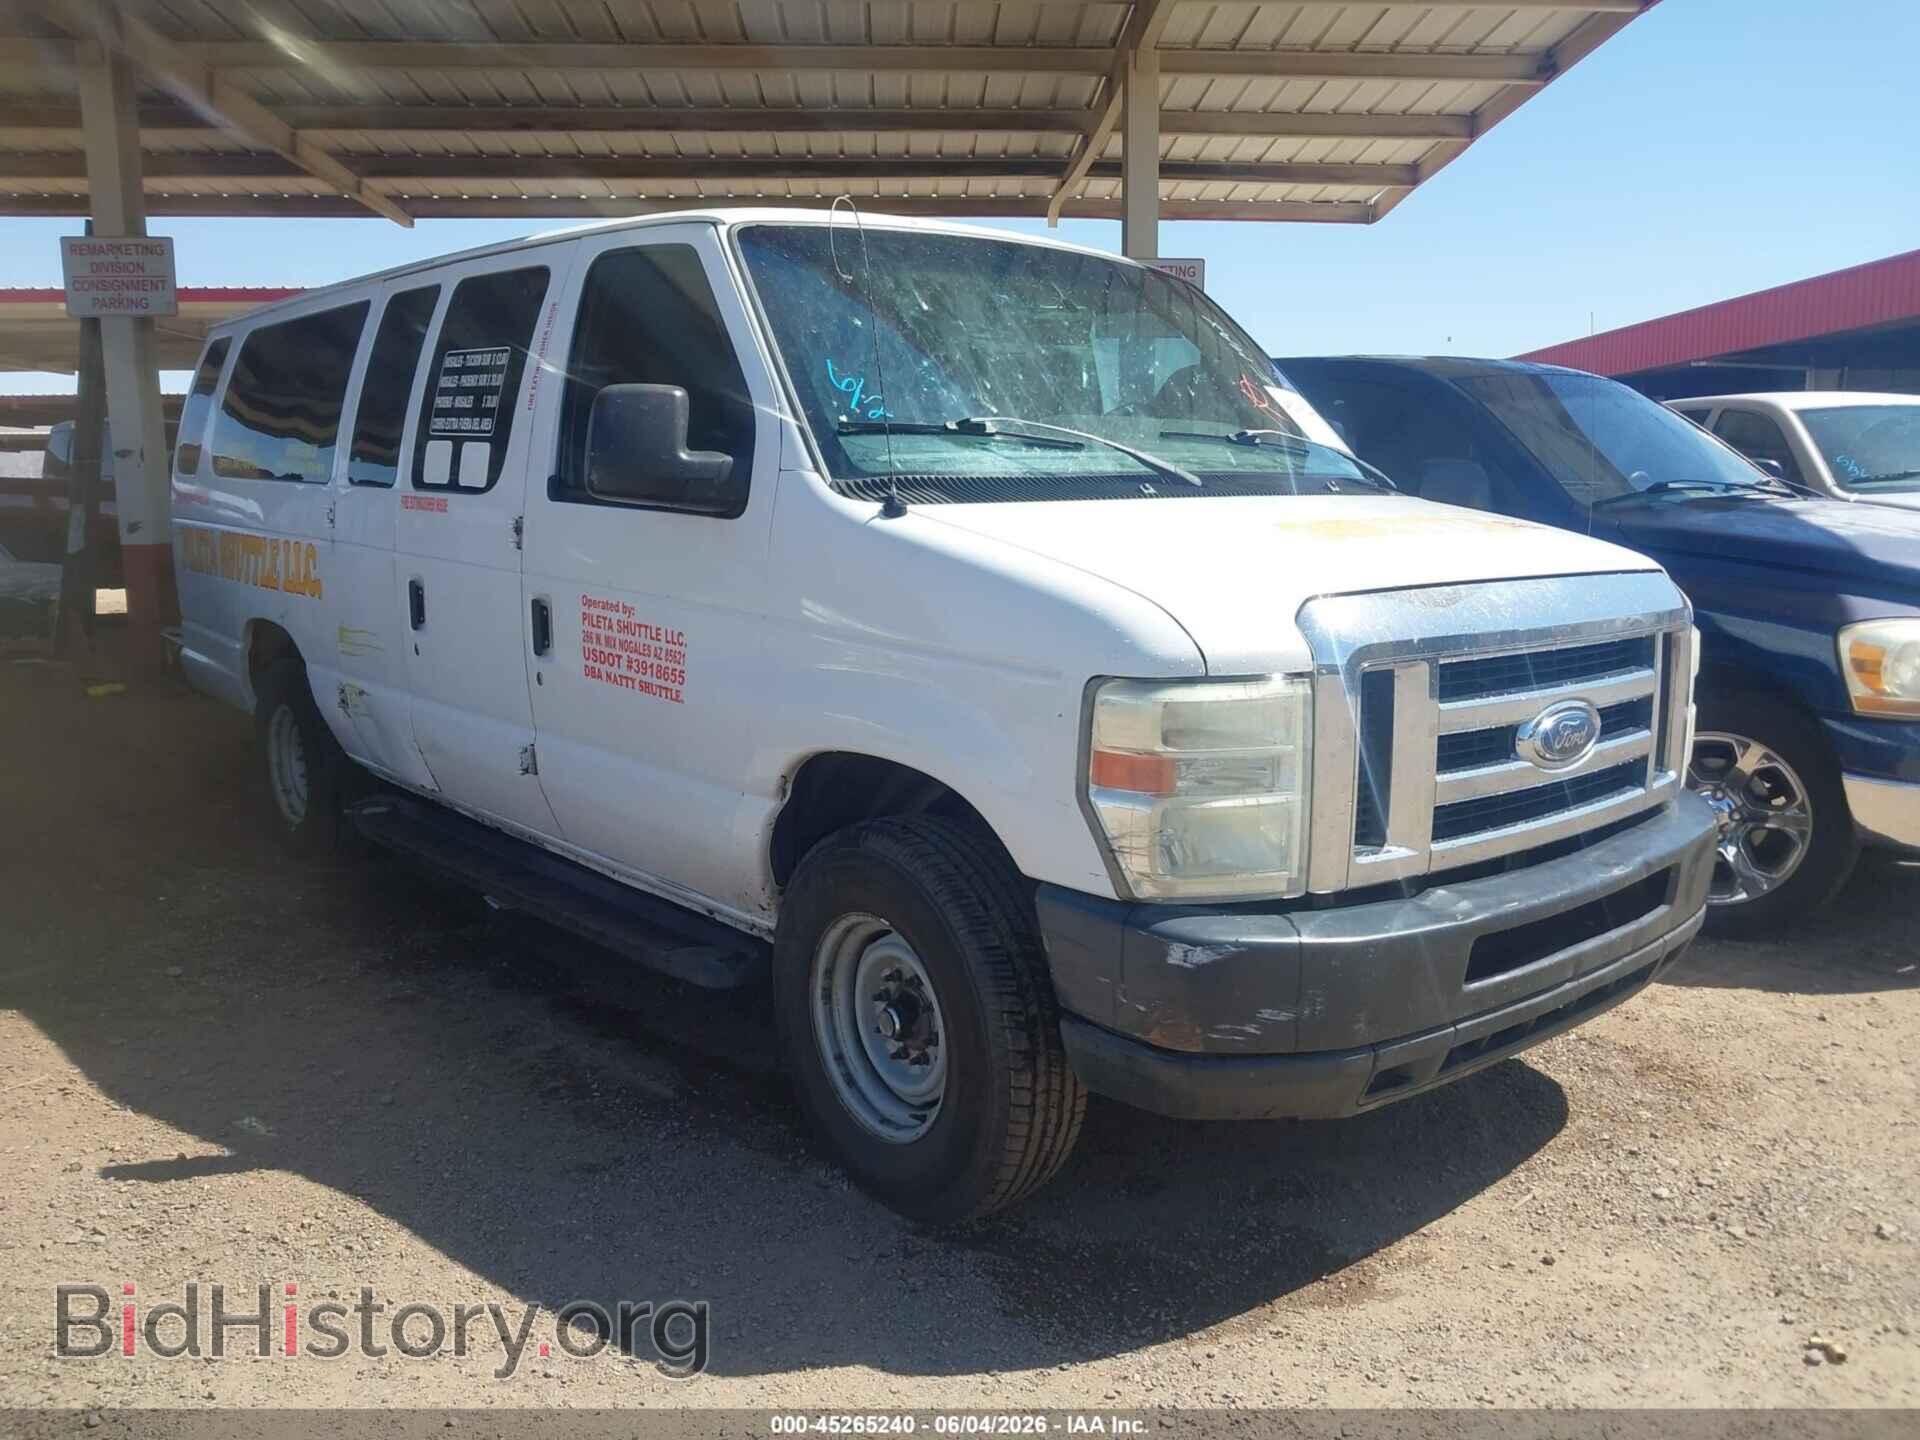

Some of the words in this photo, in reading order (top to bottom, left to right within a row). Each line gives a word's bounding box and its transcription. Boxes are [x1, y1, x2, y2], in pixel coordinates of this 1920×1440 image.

[69, 243, 166, 257] REMARKETING
[90, 261, 145, 274] DIVISION
[71, 279, 168, 293] CONSIGNMENT
[92, 297, 150, 311] PARKING
[582, 594, 620, 613] Operated
[622, 602, 636, 618] by:
[582, 612, 614, 633] PILETA
[616, 618, 662, 643] SHUTTLE
[665, 628, 688, 649] LLC.
[618, 638, 651, 658] NOGALES
[653, 646, 663, 661] AZ
[583, 646, 623, 669] USDOT
[626, 654, 686, 686] #3918655
[584, 664, 603, 681] DBA
[606, 671, 637, 690] NATTY
[1554, 719, 1588, 749] Ford
